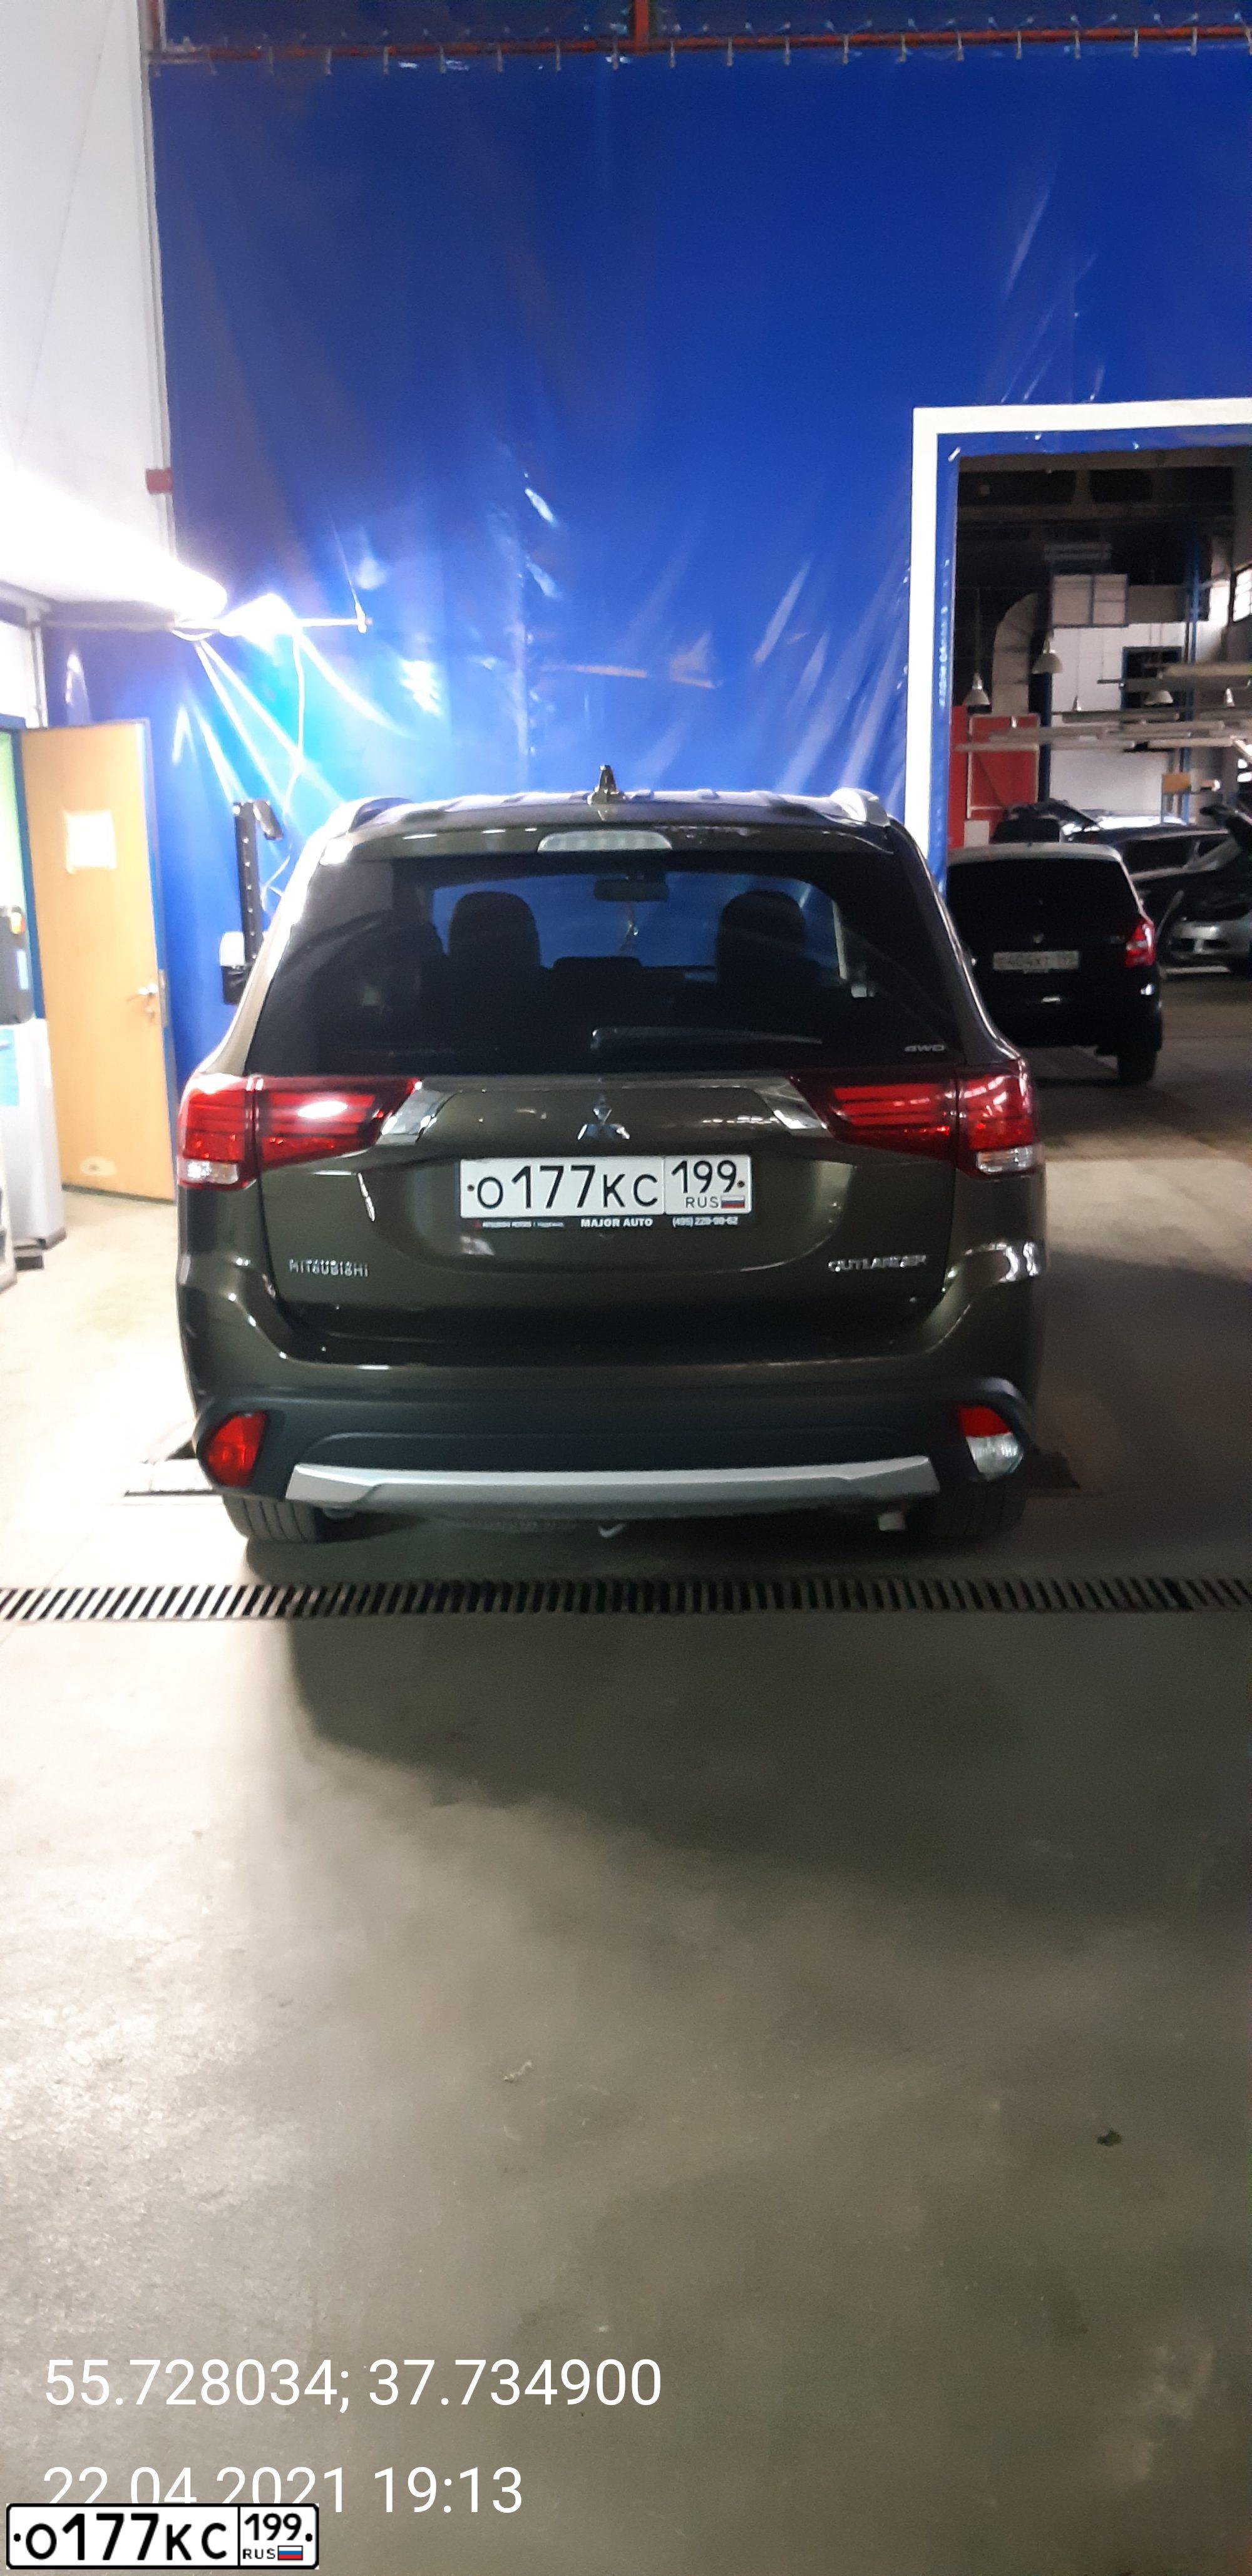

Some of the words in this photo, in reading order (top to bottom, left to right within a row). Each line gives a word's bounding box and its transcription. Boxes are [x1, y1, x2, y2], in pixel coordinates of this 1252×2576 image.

[671, 1160, 737, 1194] 199
[685, 1196, 719, 1208] RUS
[580, 1218, 620, 1227] MAJOR
[623, 1217, 653, 1227] AUTO
[289, 1259, 369, 1277] MITSUBISHI
